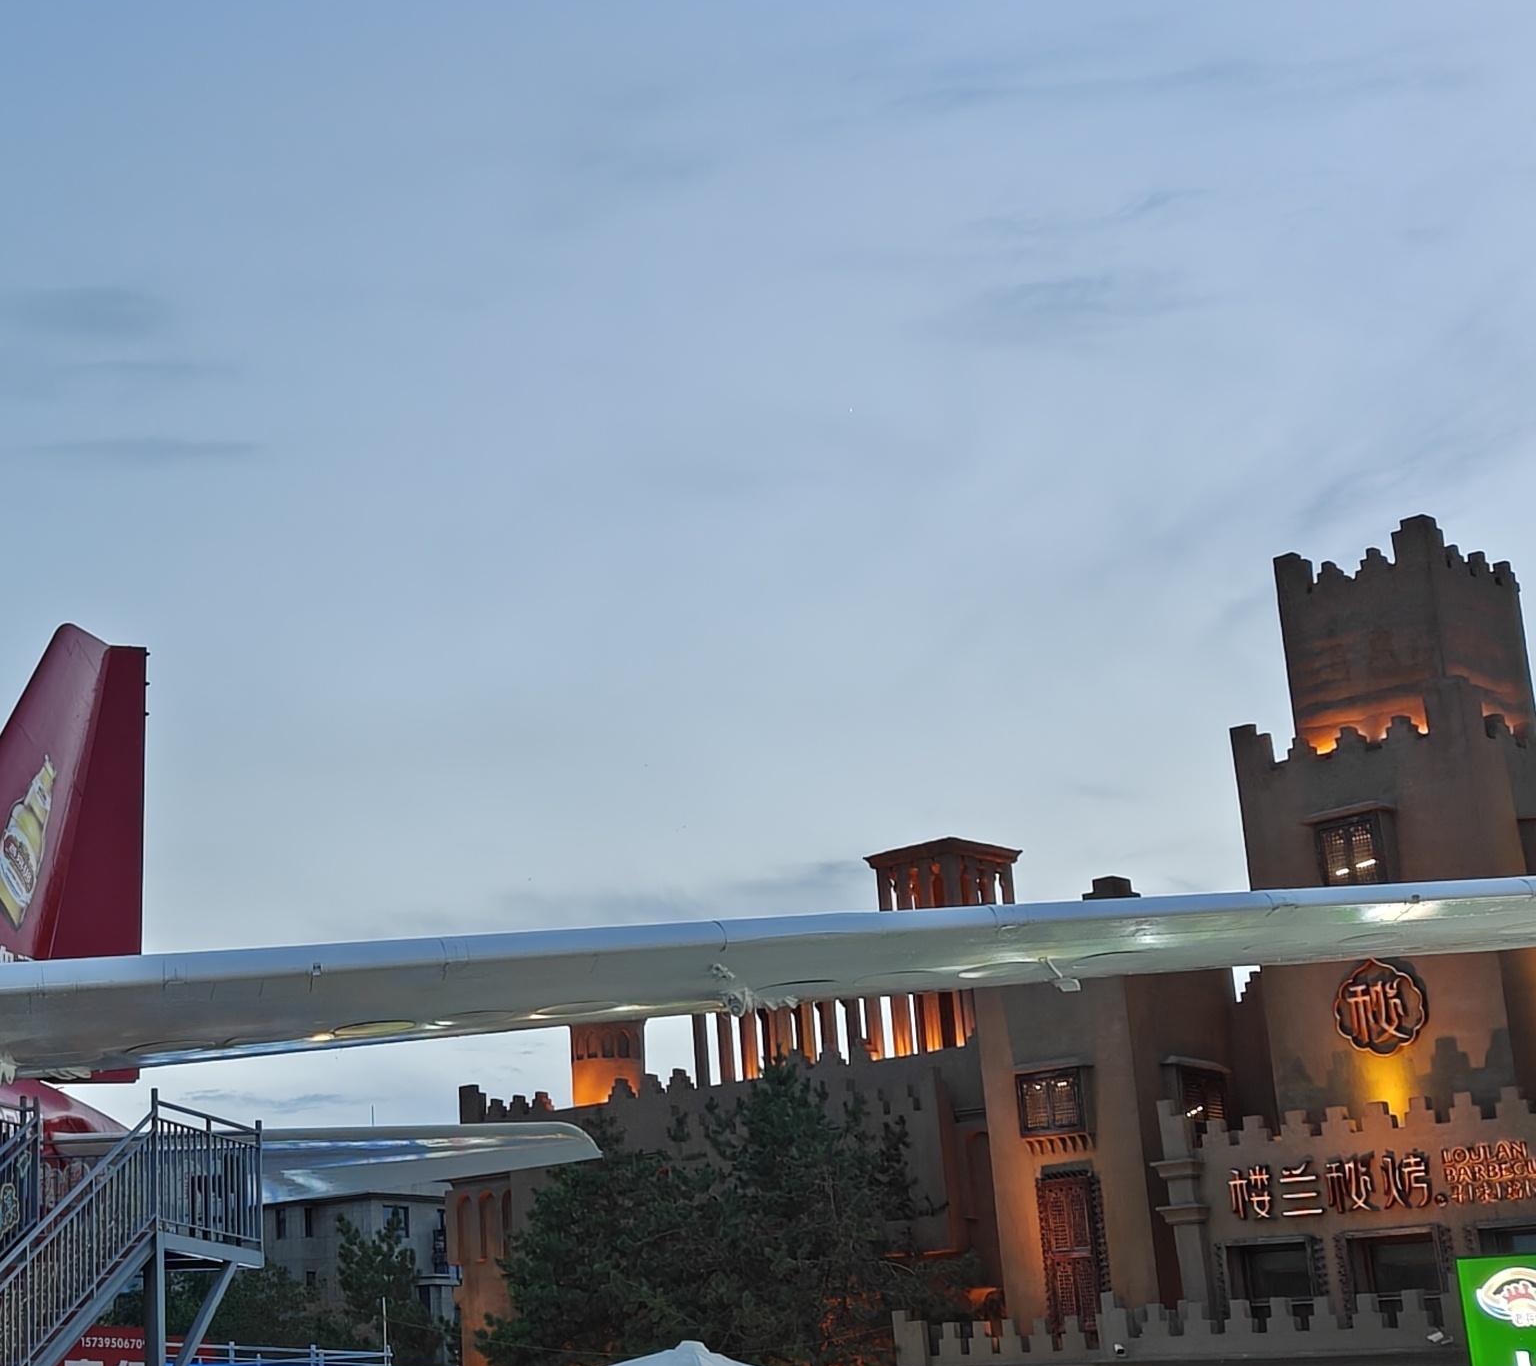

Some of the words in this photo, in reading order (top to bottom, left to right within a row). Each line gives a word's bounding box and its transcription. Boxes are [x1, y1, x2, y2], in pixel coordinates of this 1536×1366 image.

[1347, 978, 1405, 1042] 秘
[1441, 1141, 1528, 1165] LOULAN
[1229, 1150, 1434, 1219] 楼兰秘烤
[81, 1337, 146, 1350] 1573950670
